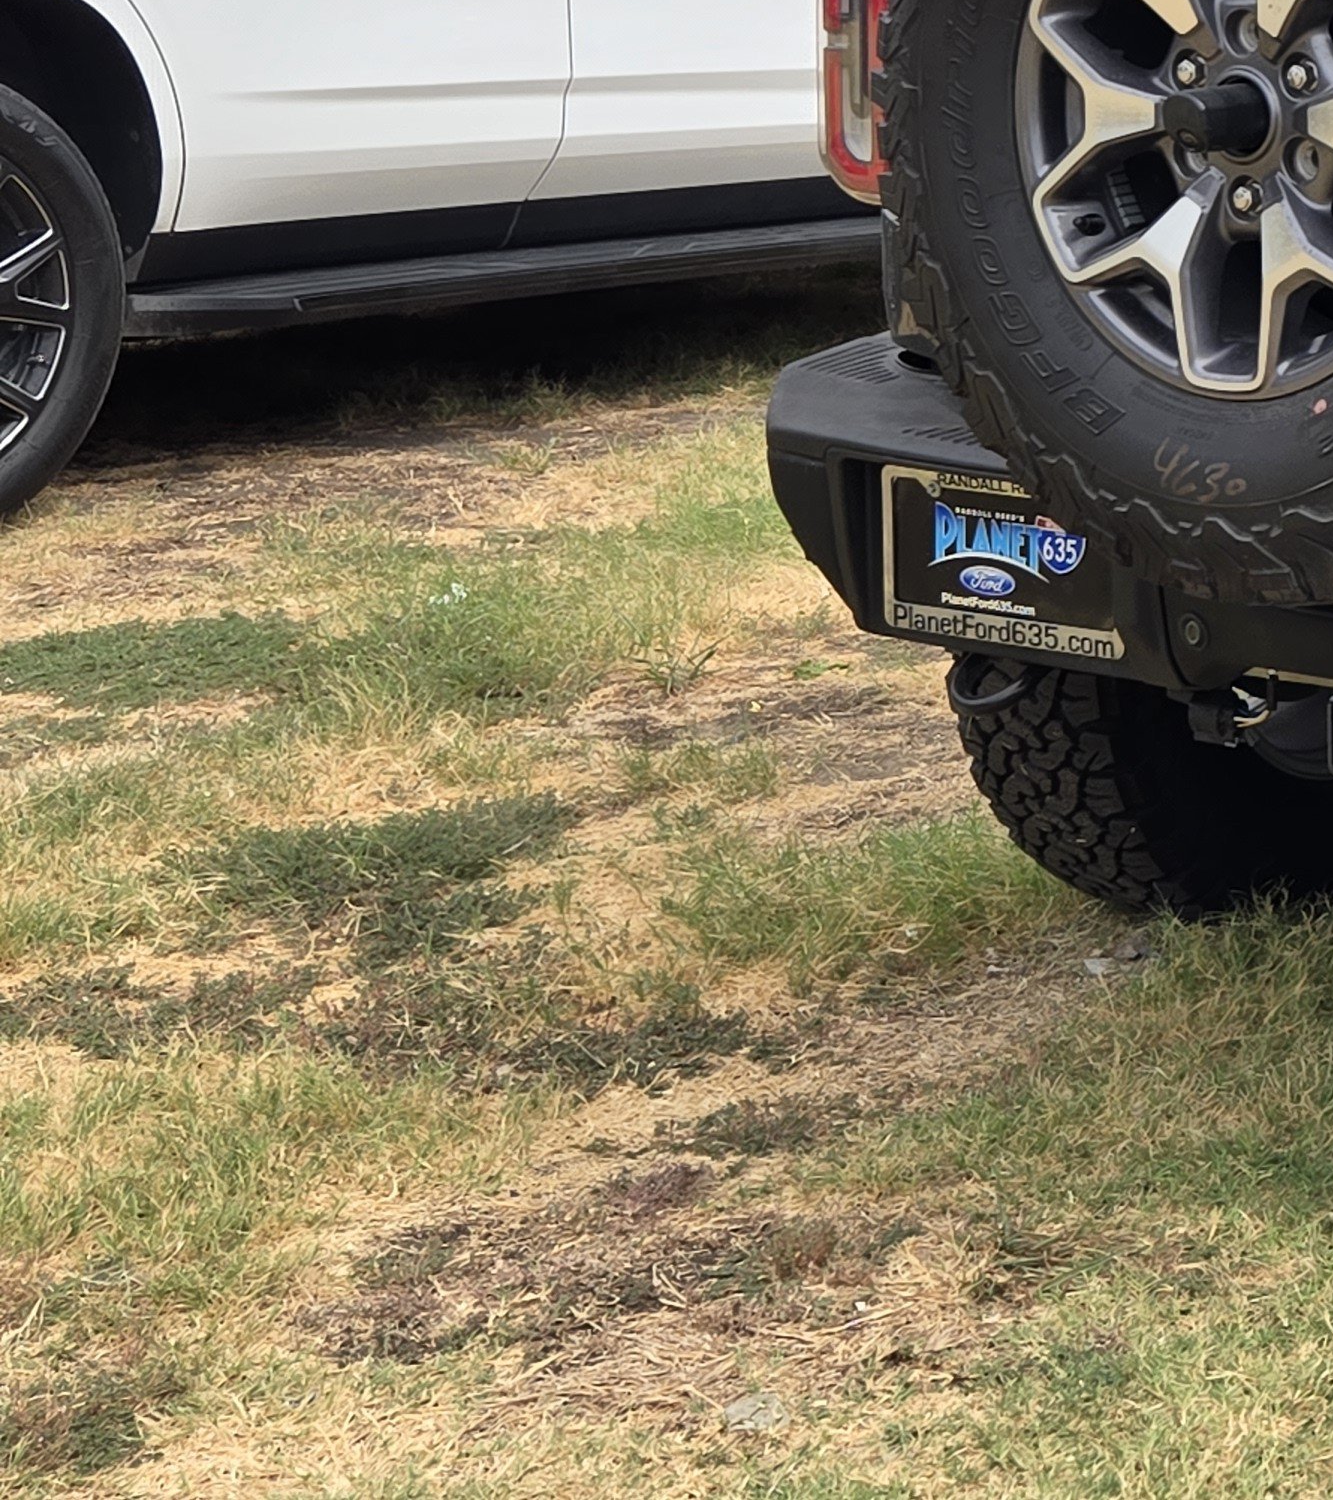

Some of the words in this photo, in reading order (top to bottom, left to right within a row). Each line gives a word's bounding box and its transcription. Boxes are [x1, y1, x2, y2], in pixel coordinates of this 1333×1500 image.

[937, 474, 1009, 492] RANDALL
[1153, 437, 1247, 504] 4630
[934, 500, 1043, 574] PLANET
[1042, 536, 1077, 565] 635
[969, 569, 1004, 592] Ford
[941, 592, 1036, 616] PlanetFord635.com
[893, 605, 1114, 658] PlanetFord635.com
